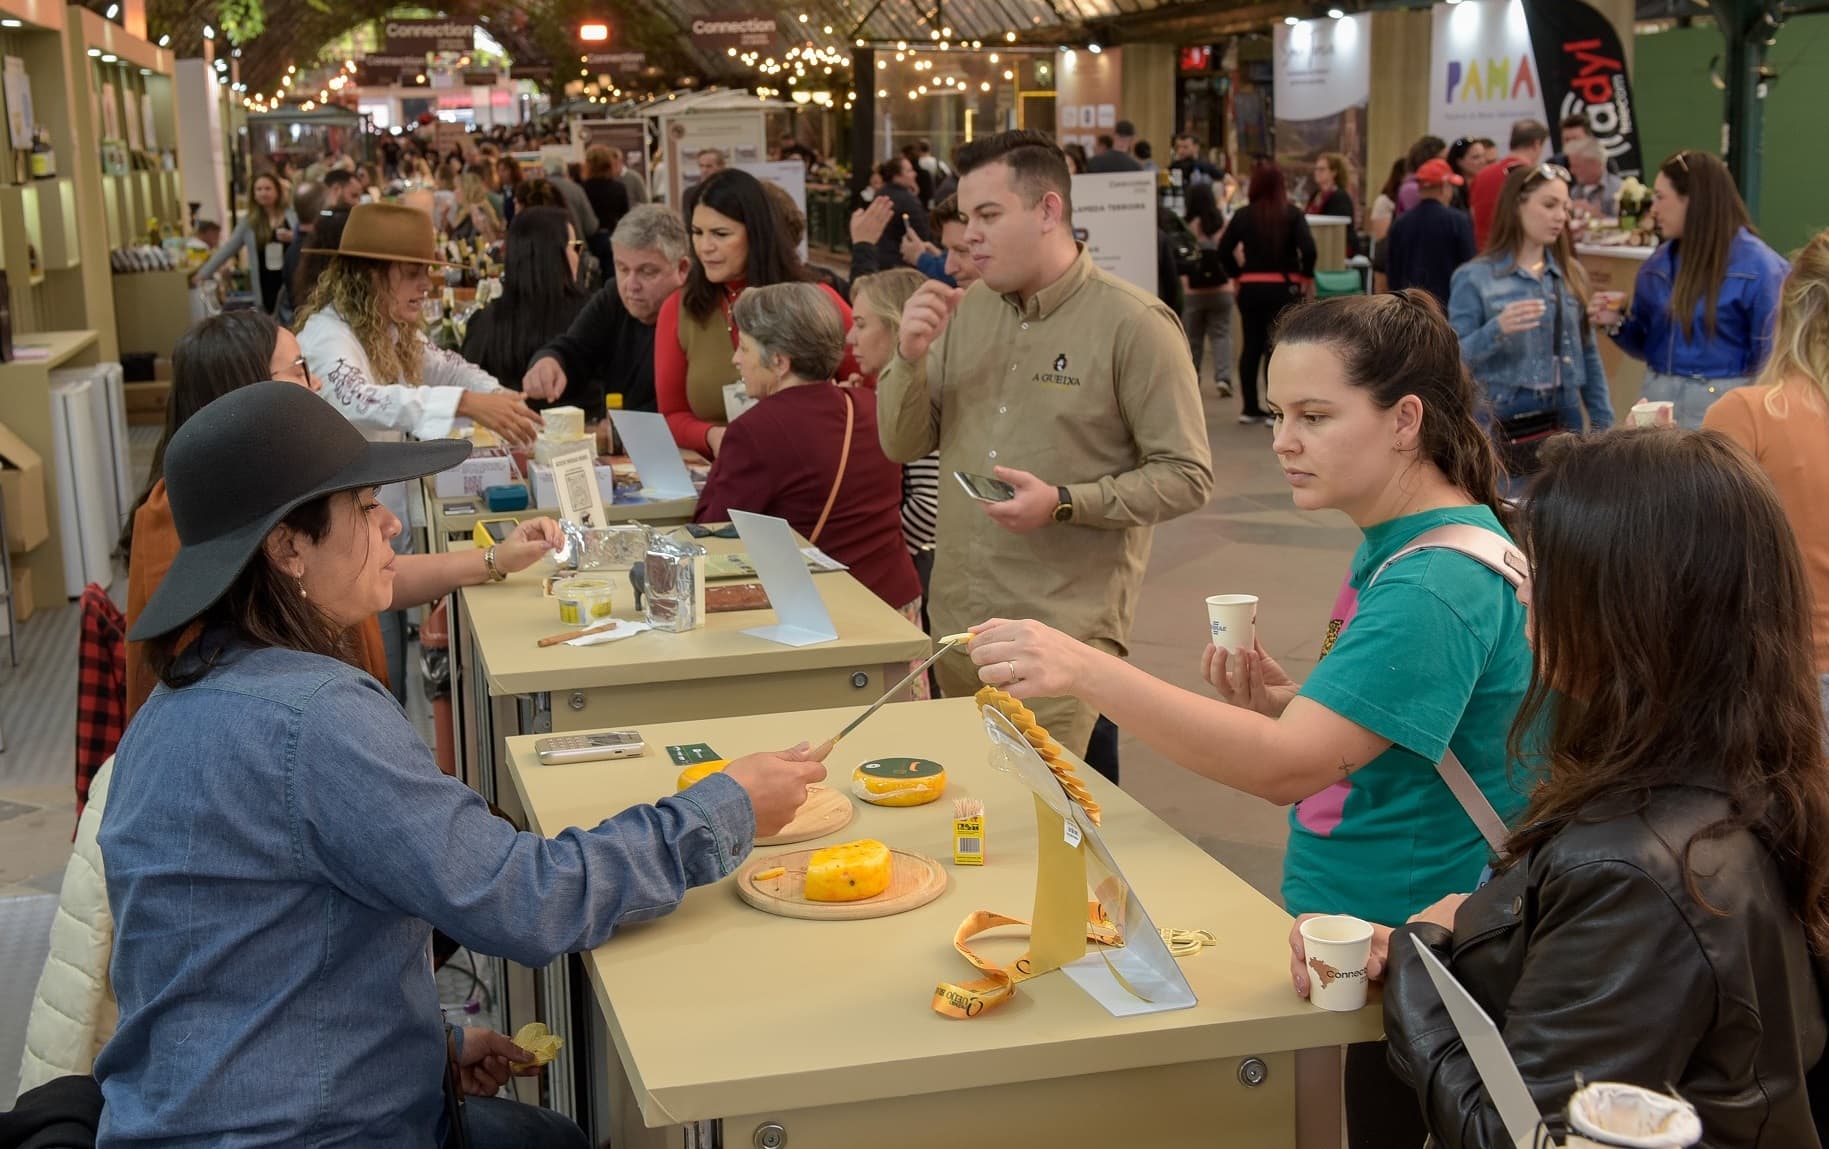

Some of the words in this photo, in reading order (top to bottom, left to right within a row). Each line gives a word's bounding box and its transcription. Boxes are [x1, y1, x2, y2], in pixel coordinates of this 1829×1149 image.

[386, 22, 473, 38] Connection
[691, 19, 777, 34] Connection
[1445, 53, 1536, 104] PAMA
